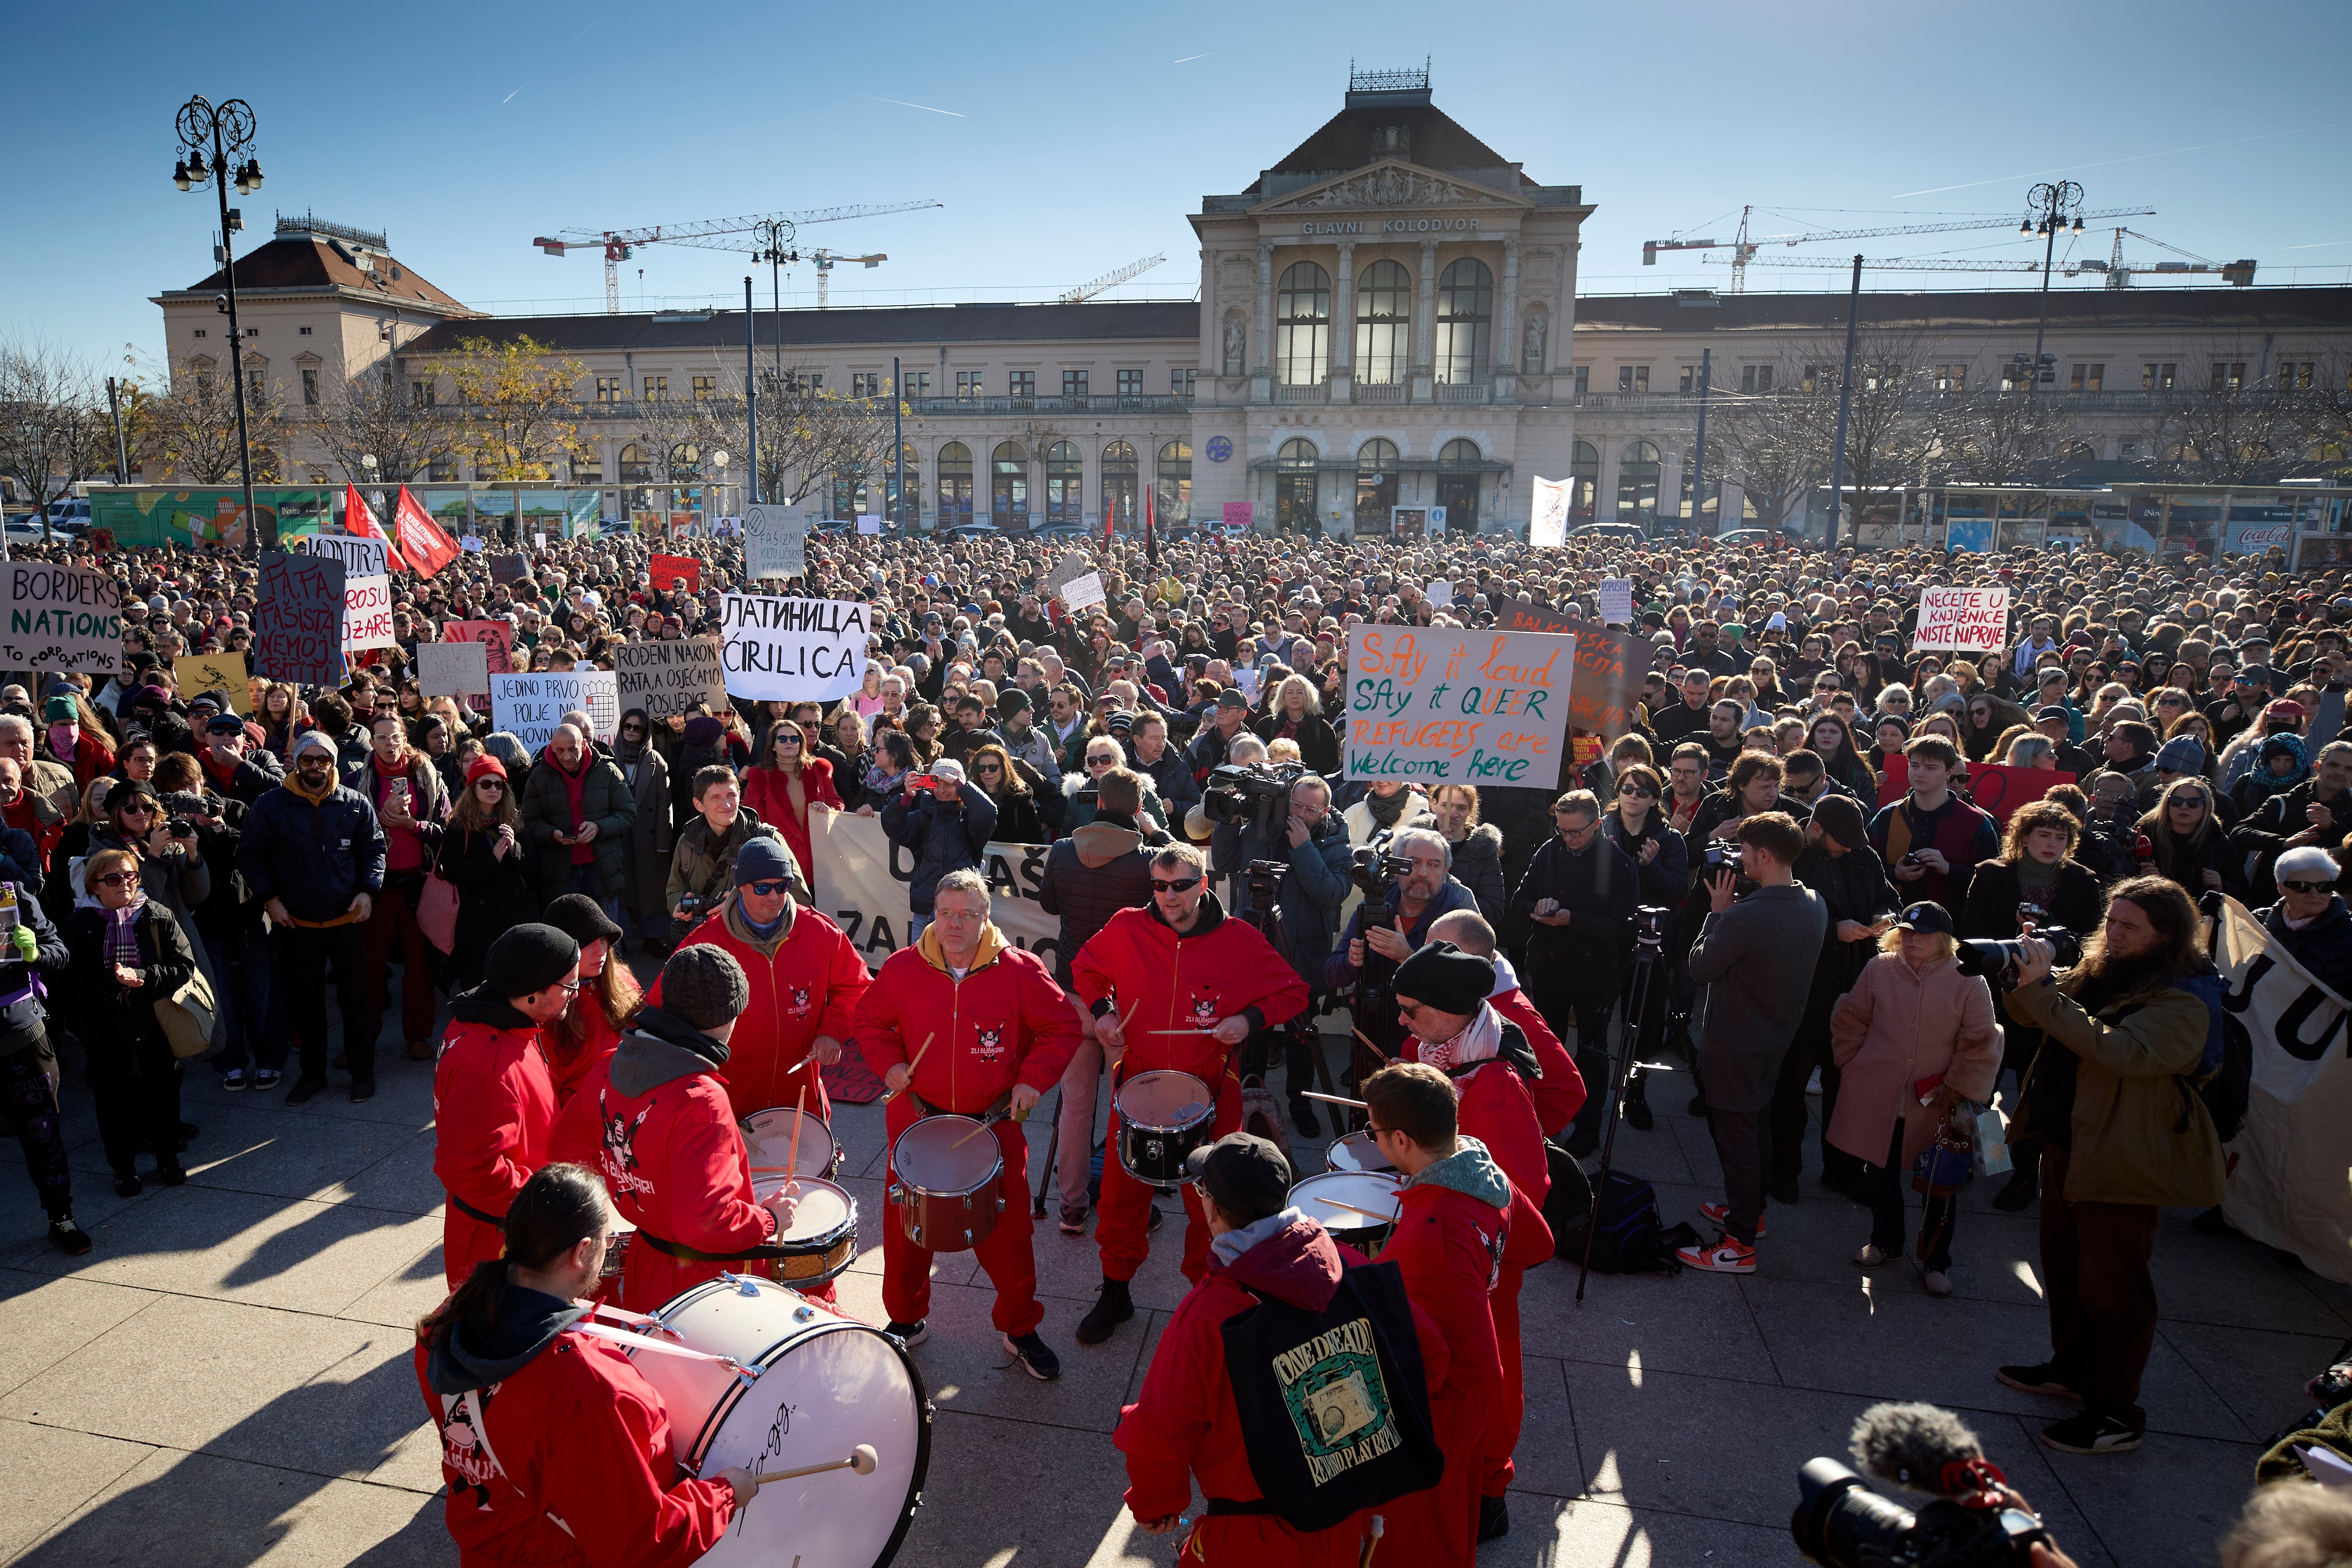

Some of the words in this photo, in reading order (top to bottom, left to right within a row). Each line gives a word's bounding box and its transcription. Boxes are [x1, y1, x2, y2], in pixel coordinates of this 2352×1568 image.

[1302, 222, 1363, 235] GLAVNI
[1383, 218, 1480, 232] KOLODVOR
[400, 518, 428, 546] COMMUNIST
[405, 511, 443, 550] REVOLUTIONARY
[760, 531, 801, 546] FAŠIZMU
[760, 548, 777, 559] KULTU
[1047, 566, 1065, 586] PRVO
[13, 569, 120, 609] BORDERS
[1989, 593, 2003, 608] U
[11, 608, 121, 639] NATIONS
[722, 597, 865, 641] ЛАТИНИЦА
[1929, 607, 2004, 624] KNJIŽNICE
[3, 646, 23, 661] TO
[30, 646, 116, 669] CORPORATIONS
[617, 645, 670, 668] ROĐENI
[674, 643, 717, 665] NAKON
[723, 632, 855, 679] ĆIRILICA
[1478, 636, 1561, 687] loud
[421, 675, 457, 686] DOBRO
[666, 665, 720, 688] OSJEĆAMO
[498, 679, 539, 700] JEDINO
[545, 680, 579, 699] PRVO
[513, 703, 550, 723] POLJE
[1461, 686, 1548, 721] QUEER
[1351, 719, 1485, 758] REFUGEES
[1497, 731, 1549, 754] are
[1466, 748, 1530, 781] here
